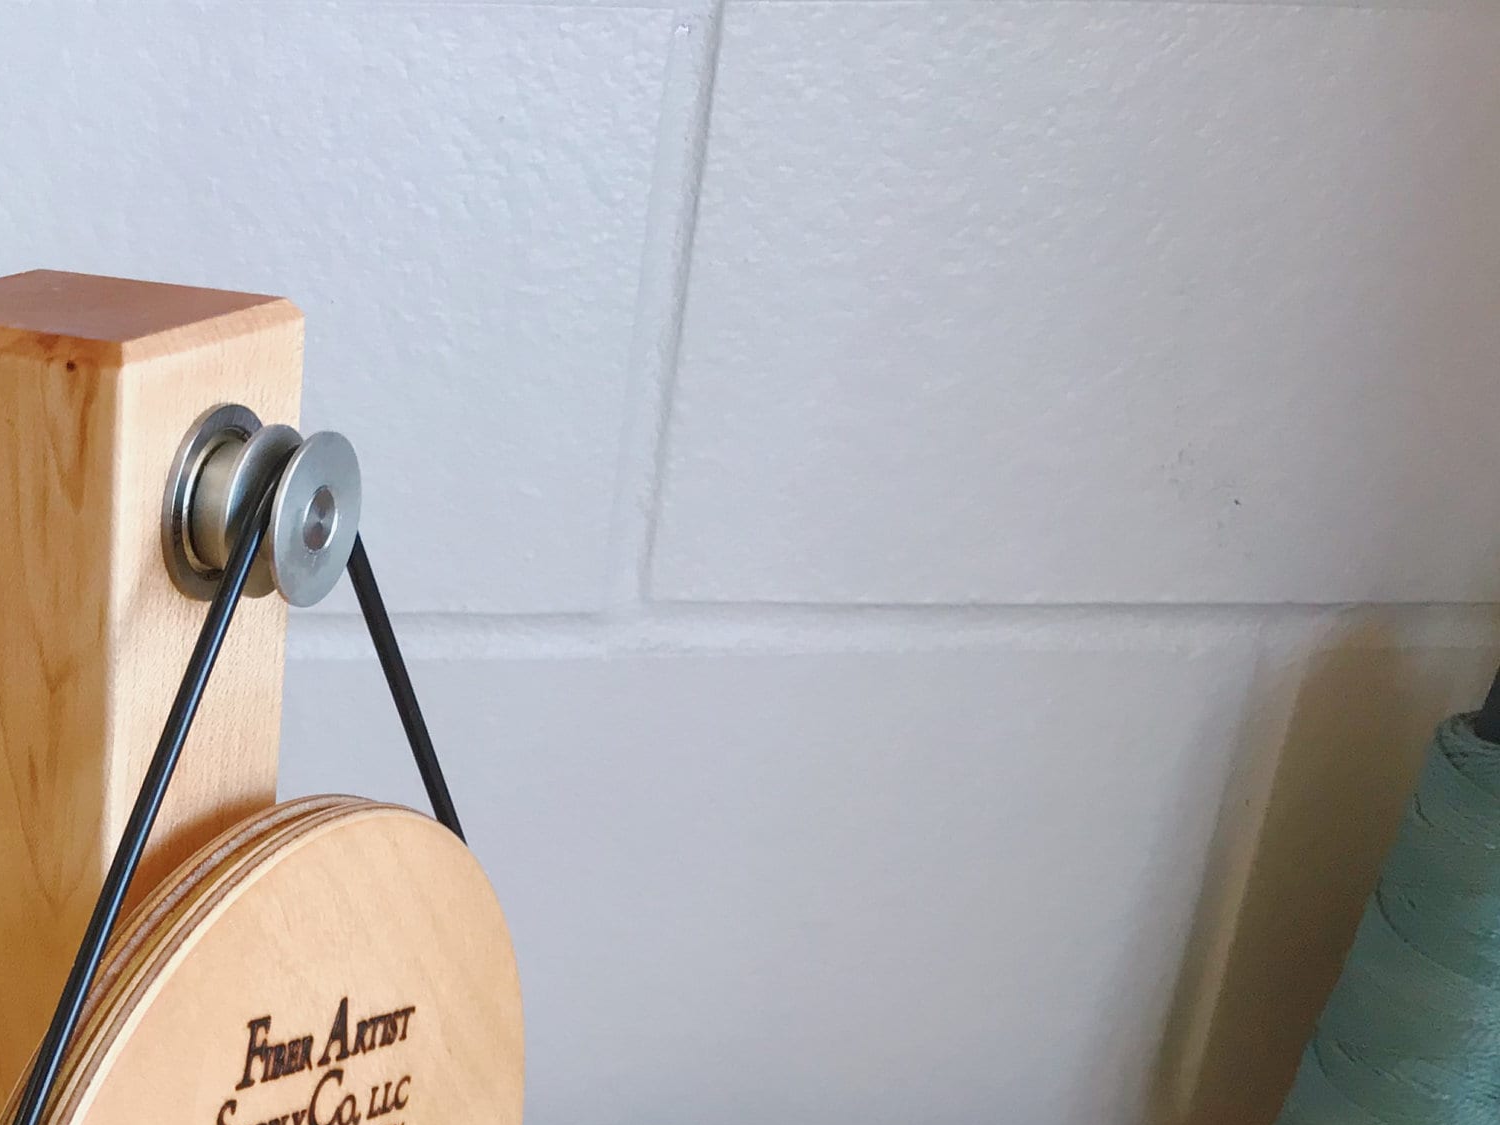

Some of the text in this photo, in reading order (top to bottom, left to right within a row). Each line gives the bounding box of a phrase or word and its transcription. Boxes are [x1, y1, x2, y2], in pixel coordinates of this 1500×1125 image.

[235, 996, 416, 1091] FIBER ARTIST
[366, 1075, 411, 1120] LLC
